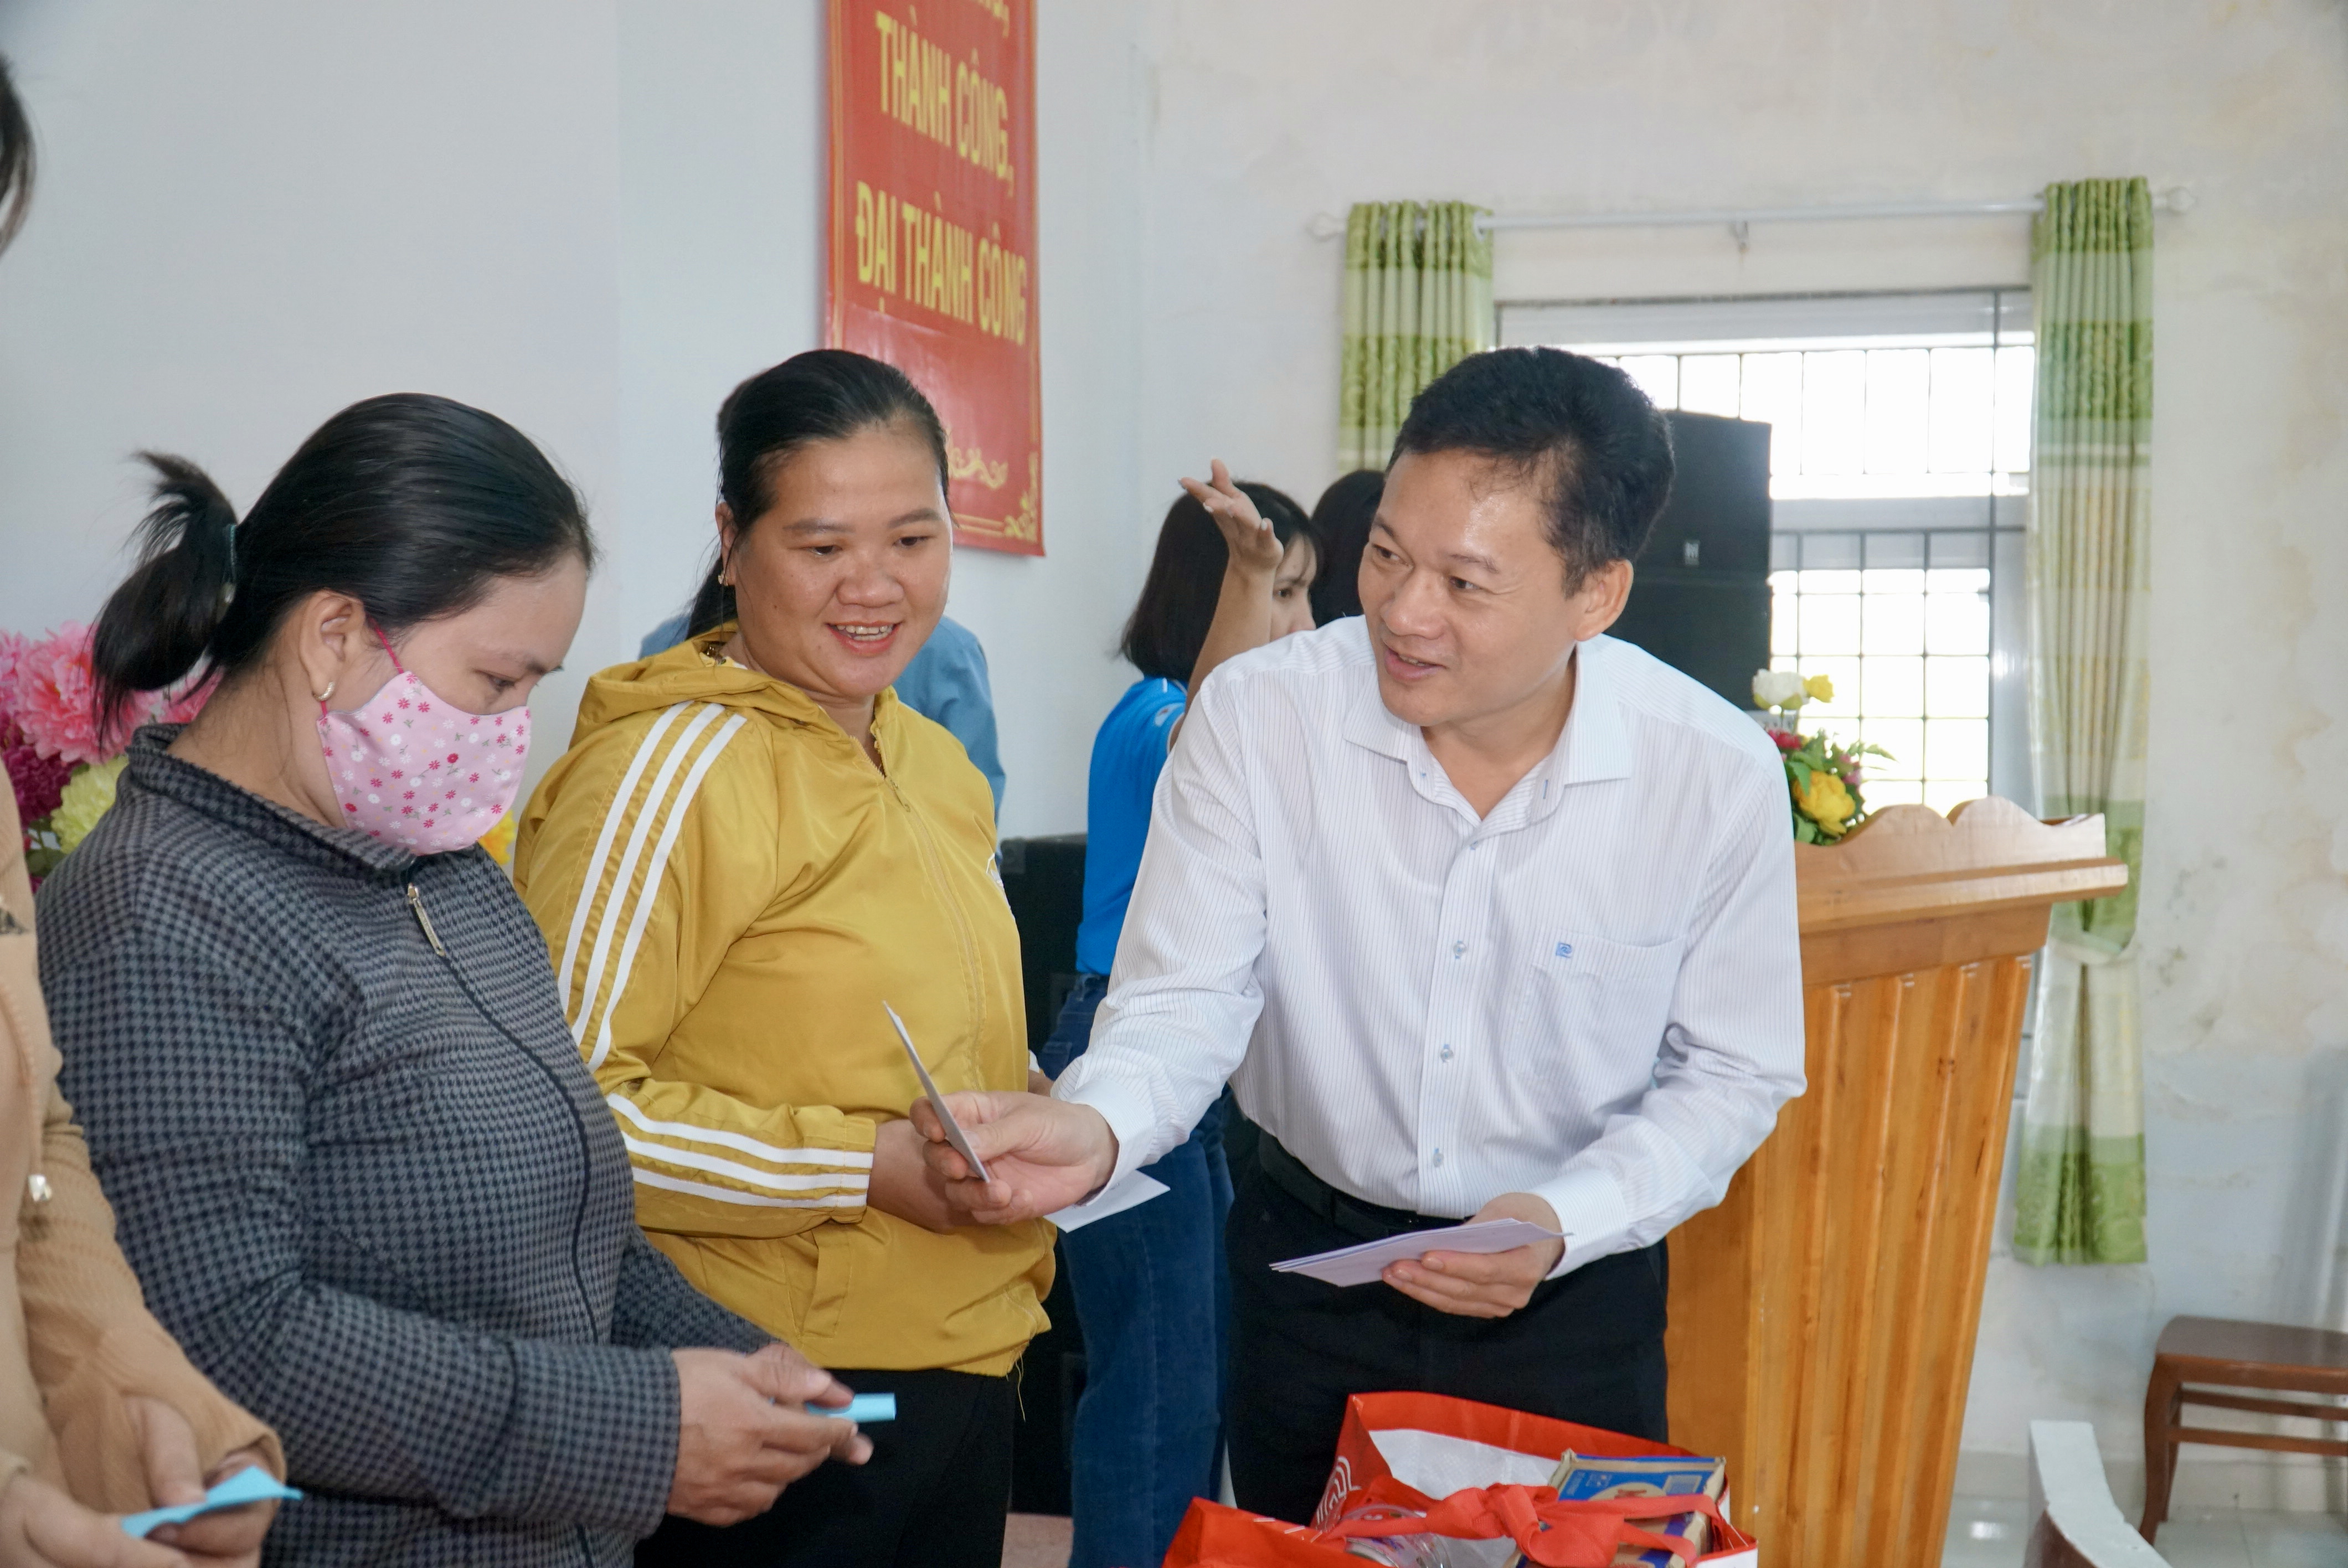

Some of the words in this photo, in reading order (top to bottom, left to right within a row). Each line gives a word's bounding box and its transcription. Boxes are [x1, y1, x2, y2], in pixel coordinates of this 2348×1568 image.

[876, 5, 951, 148] THÀNH
[956, 47, 1014, 198] CÔNG,
[856, 180, 897, 313] ĐẠI
[902, 190, 973, 325] THÀNH
[979, 222, 1027, 347] CÔNG
